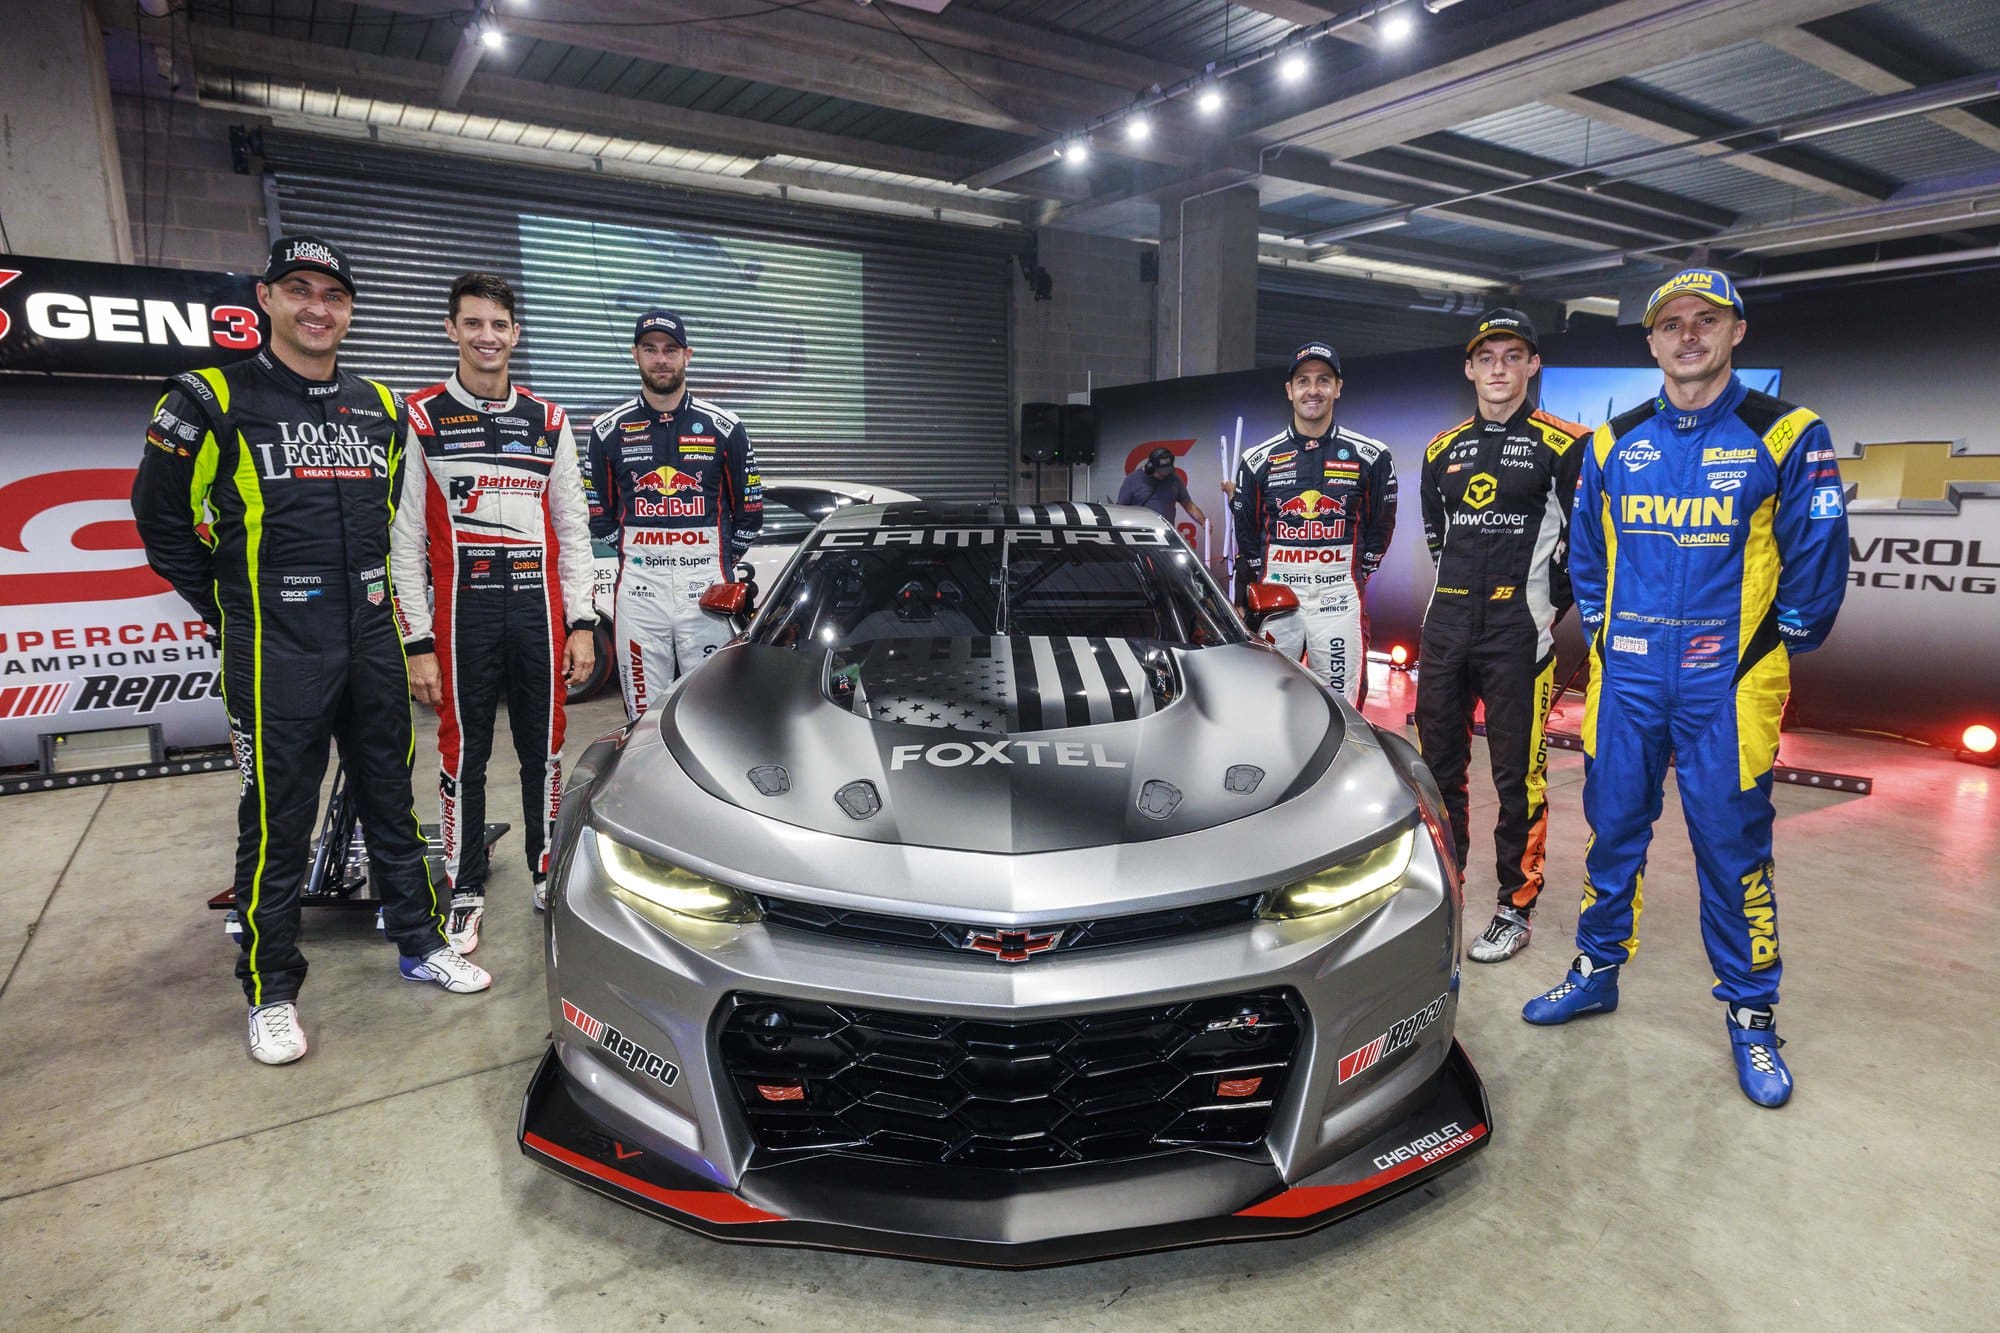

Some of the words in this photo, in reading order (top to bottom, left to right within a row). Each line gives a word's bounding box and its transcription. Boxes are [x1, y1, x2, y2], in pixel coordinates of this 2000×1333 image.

[294, 241, 331, 256] LOCAL
[284, 248, 339, 270] LEGENDS
[26, 292, 262, 350] GEN3
[439, 415, 479, 425] TIMKEN
[599, 420, 613, 433] OMP
[715, 417, 732, 432] OMP
[277, 422, 369, 445] LOCAL
[440, 427, 485, 436] Blackwoods
[1548, 434, 1567, 447] OMP
[1250, 453, 1264, 466] OMP
[1361, 446, 1378, 459] OMP
[1618, 450, 1662, 461] FUCHS
[1714, 448, 1757, 459] Century
[256, 443, 388, 480] LEGENDS
[1500, 458, 1534, 469] Kubota
[303, 469, 330, 478] MEAT
[330, 469, 366, 478] SNACKS
[1707, 470, 1748, 480] SEIKO
[477, 475, 543, 489] Batteries
[1327, 478, 1357, 486] ACDelco
[635, 496, 668, 517] Red
[669, 496, 705, 516] Bull
[1620, 495, 1734, 527] IRWIN
[1276, 519, 1308, 540] Red
[1311, 519, 1346, 540] Bull
[632, 531, 710, 545] AMPOL
[820, 529, 1170, 547] CAMARO
[1680, 533, 1730, 543] RACING
[507, 550, 542, 558] PERCAT
[1272, 550, 1346, 563] AMPOL
[513, 561, 539, 570] Coates
[645, 556, 677, 568] Spirit
[679, 555, 711, 568] Super
[511, 571, 542, 579] TIMKEN
[1282, 573, 1312, 584] Spirit
[1315, 574, 1347, 584] Super
[1490, 586, 1516, 600] 35
[1319, 605, 1349, 613] WHINCUP
[0, 621, 208, 655] PERCAR
[1330, 637, 1345, 673] GIVES
[1330, 673, 1345, 697] YO
[890, 740, 1126, 771] FOXTEL
[1741, 870, 1779, 973] IRWIN
[1383, 993, 1448, 1058] Repco
[602, 1024, 680, 1088] Repco
[1373, 1122, 1466, 1170] CHEVROLET
[1421, 1132, 1474, 1163] RACING
